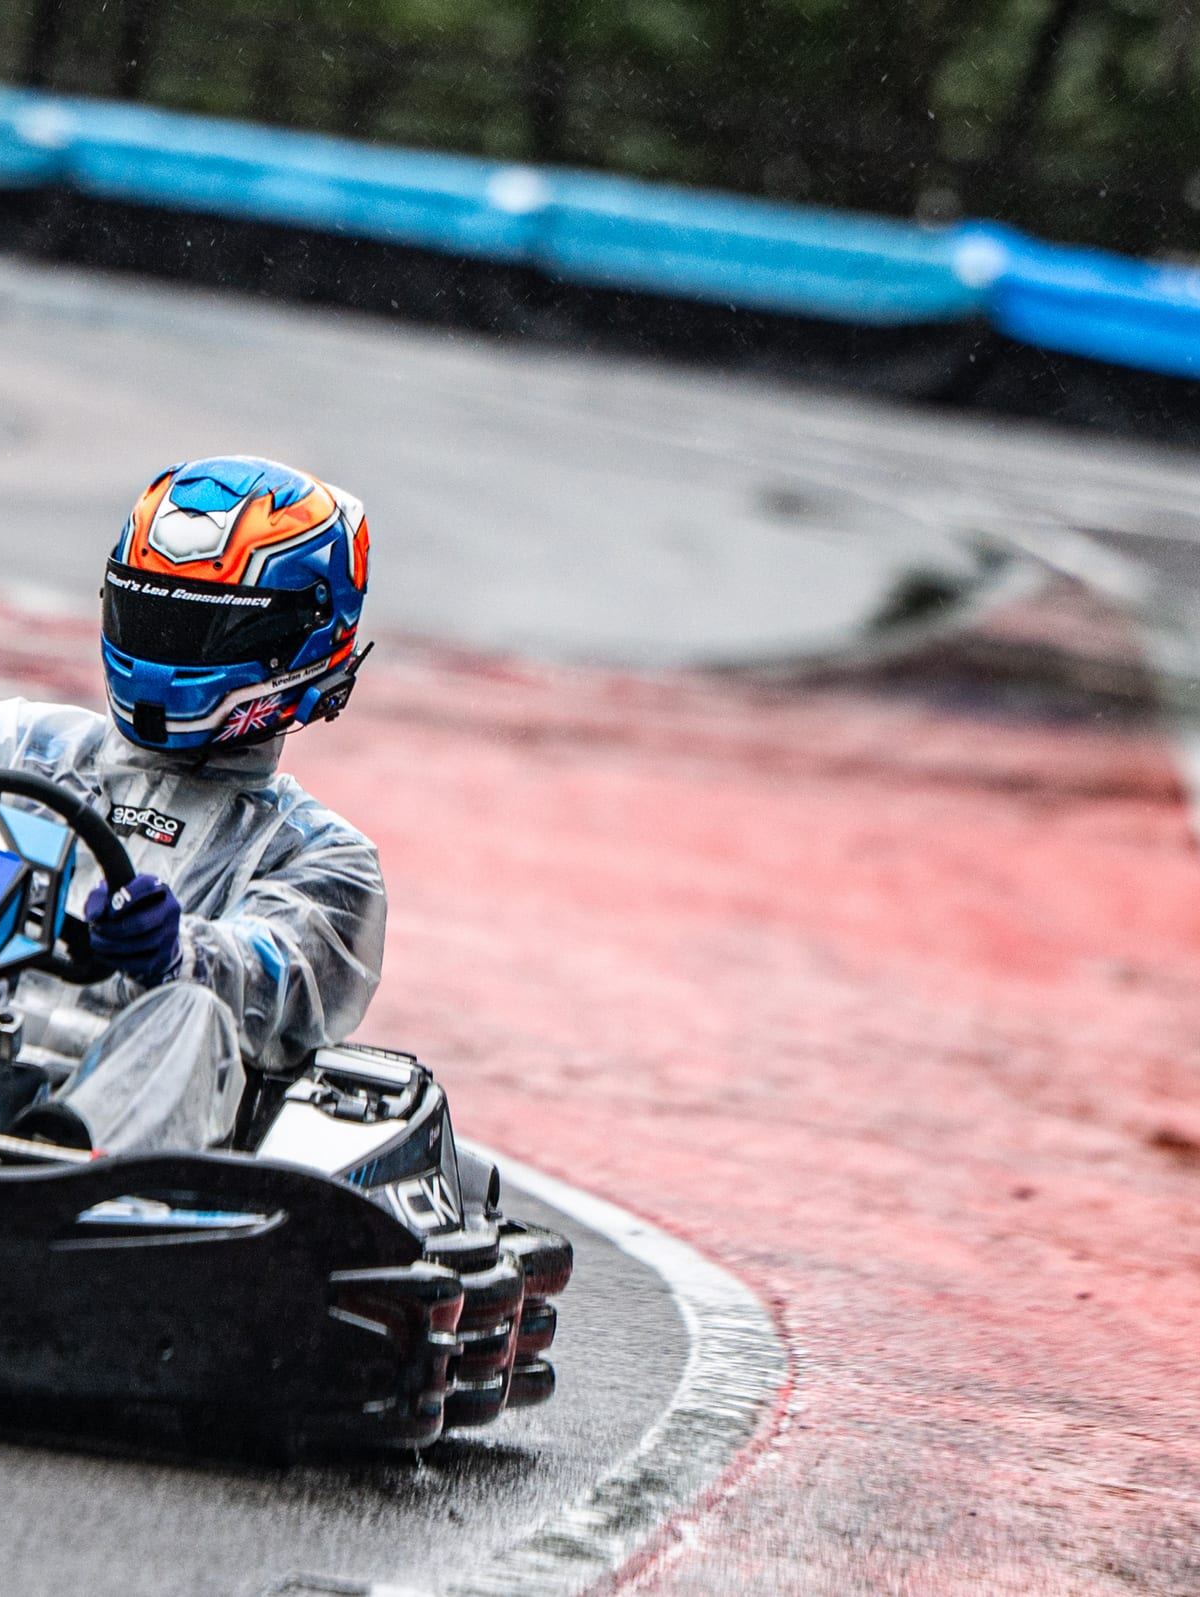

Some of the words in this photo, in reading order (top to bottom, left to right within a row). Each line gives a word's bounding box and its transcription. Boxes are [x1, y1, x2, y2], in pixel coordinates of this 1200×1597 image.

[141, 583, 170, 597] Lea
[171, 588, 272, 608] Consultancy
[112, 807, 178, 835] sparco
